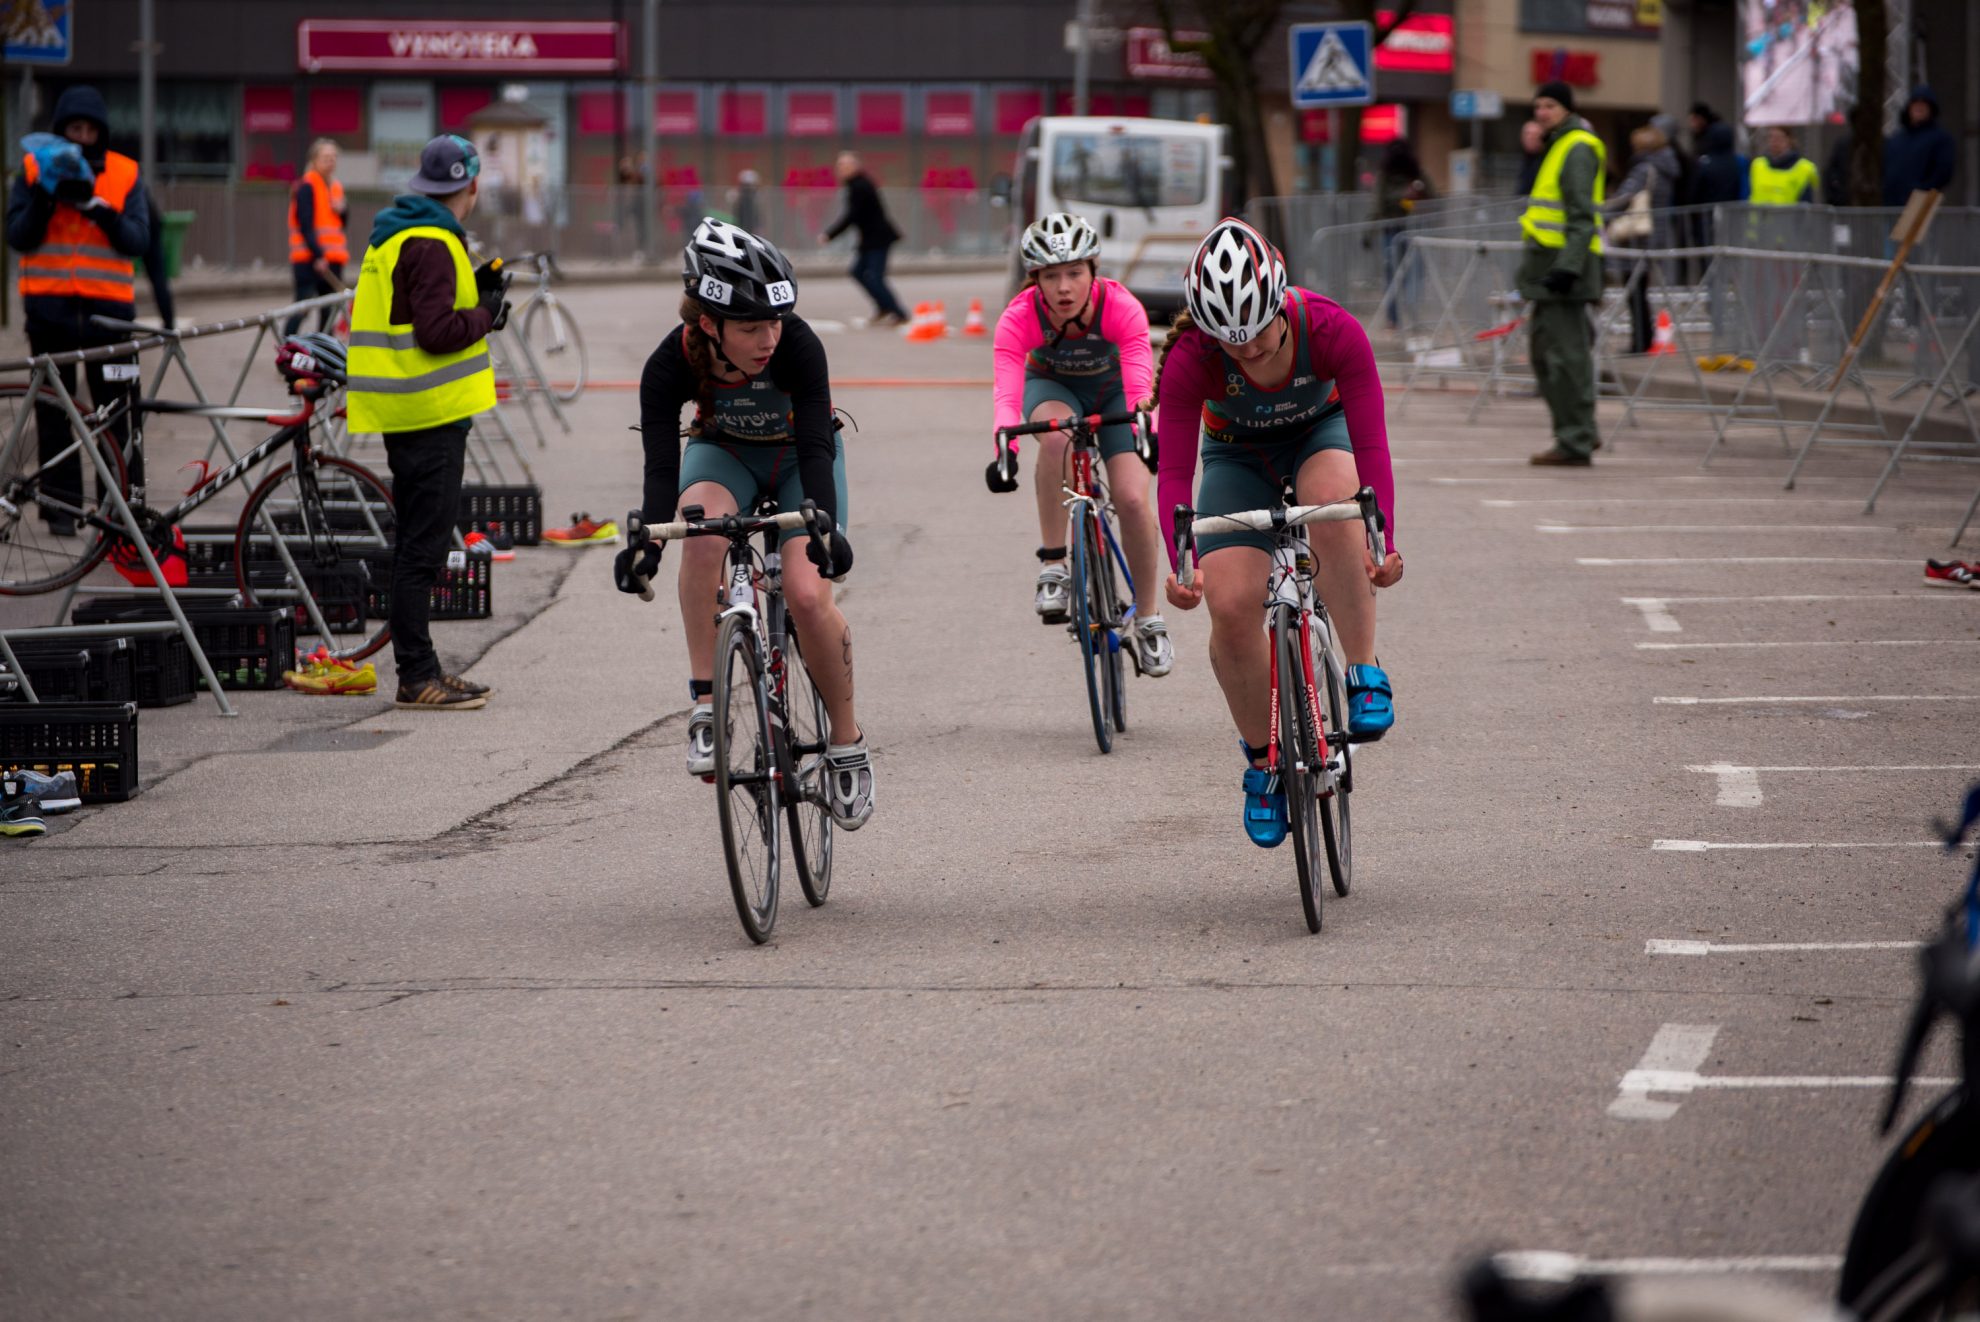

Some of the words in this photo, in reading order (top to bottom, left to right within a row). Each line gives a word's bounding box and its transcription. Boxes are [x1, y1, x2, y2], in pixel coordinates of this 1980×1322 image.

[1050, 236, 1066, 249] 84
[706, 280, 724, 300] 83
[771, 284, 789, 302] 83
[1229, 328, 1248, 343] 80
[111, 365, 122, 377] 72
[178, 437, 273, 511] SCOTT
[1271, 688, 1279, 744] PINARELLO
[1307, 683, 1324, 739] PINARELLO
